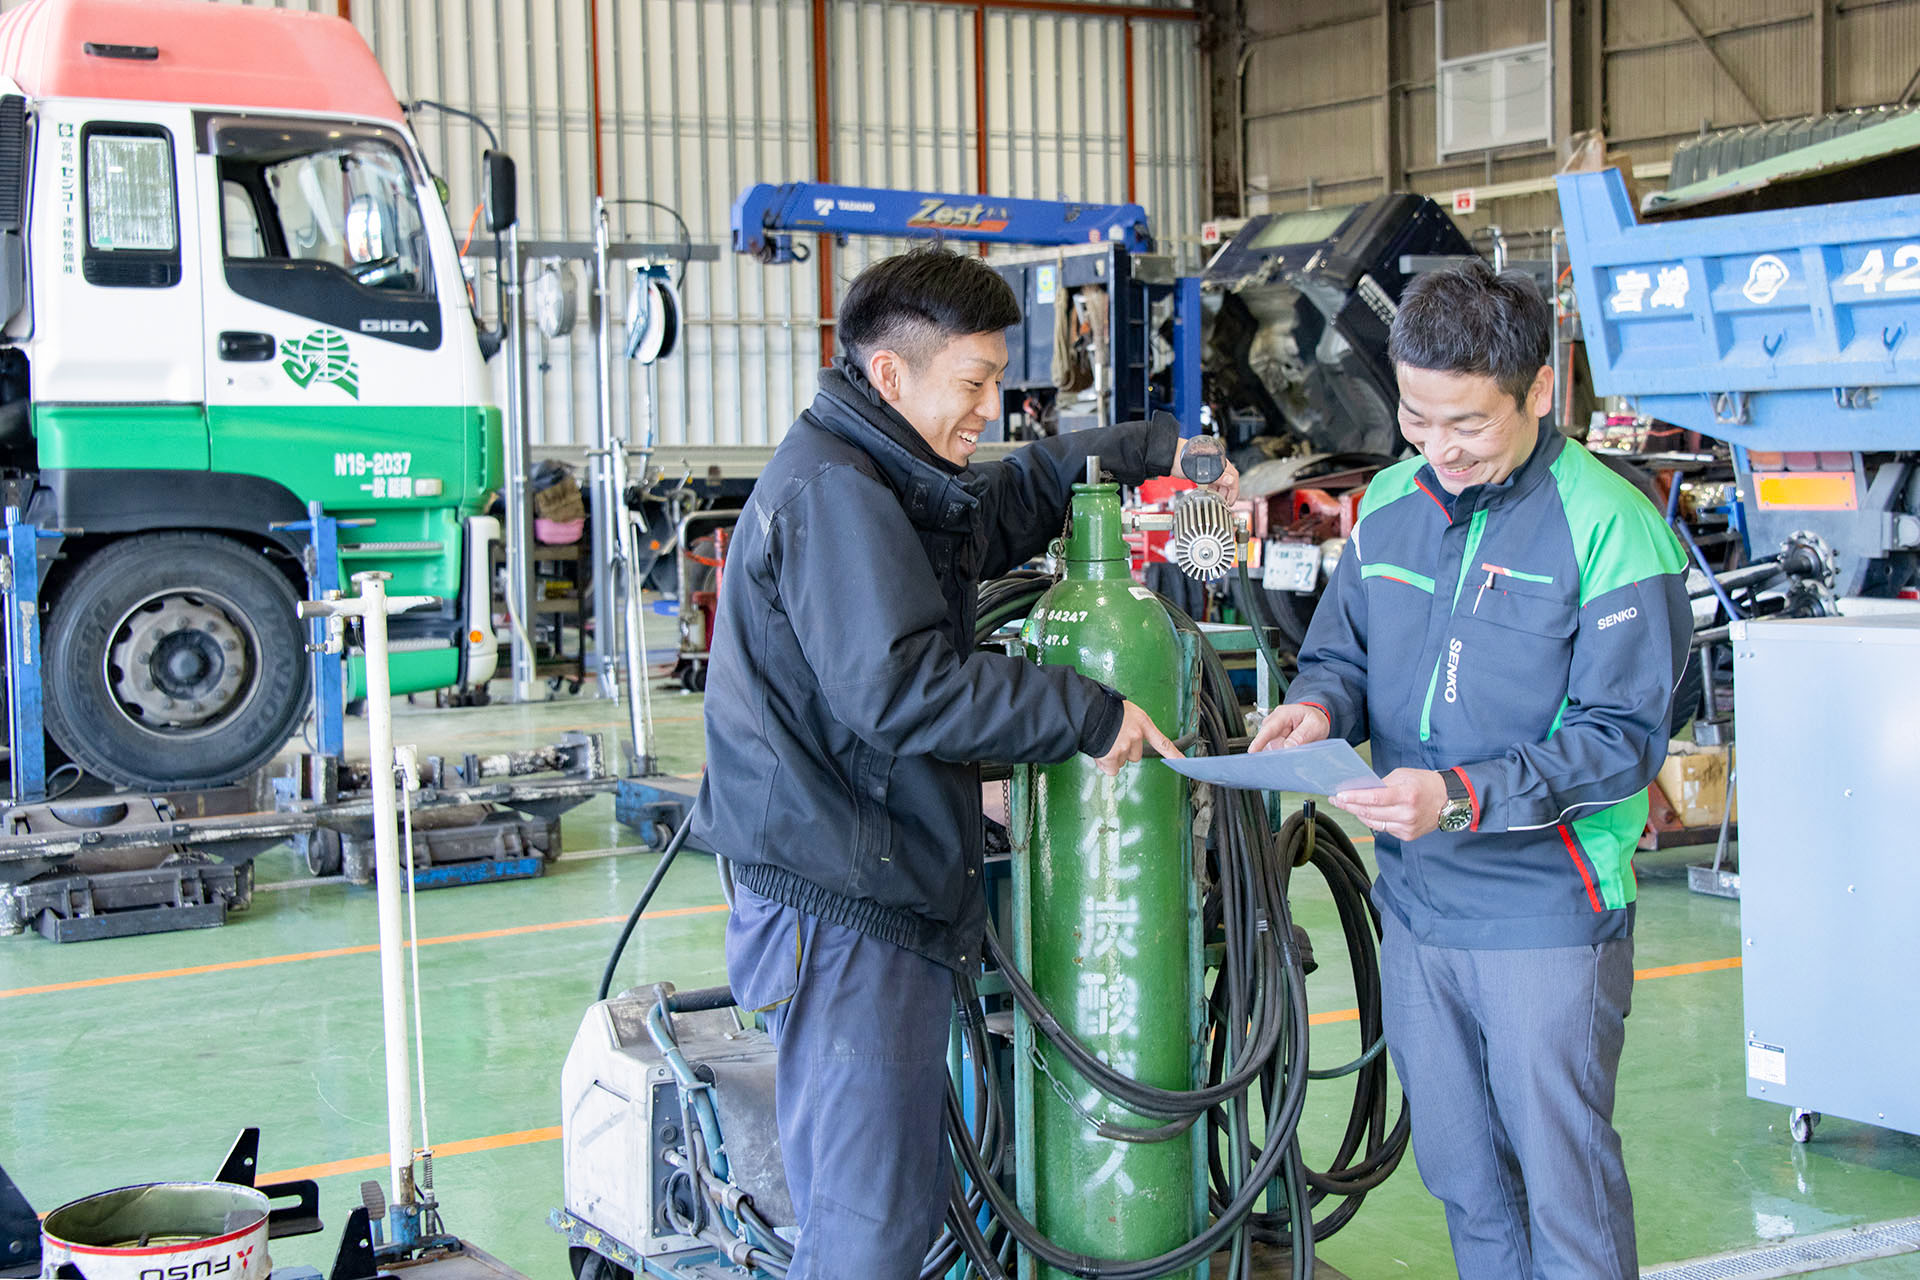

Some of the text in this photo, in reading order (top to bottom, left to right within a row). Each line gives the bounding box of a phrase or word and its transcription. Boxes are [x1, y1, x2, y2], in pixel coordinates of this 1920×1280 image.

[908, 199, 985, 227] Zest
[1844, 246, 1920, 293] 42
[360, 319, 430, 333] GIGA
[1597, 607, 1637, 630] SENKO
[1444, 638, 1463, 703] SENKO
[140, 1254, 231, 1280] FUSO
